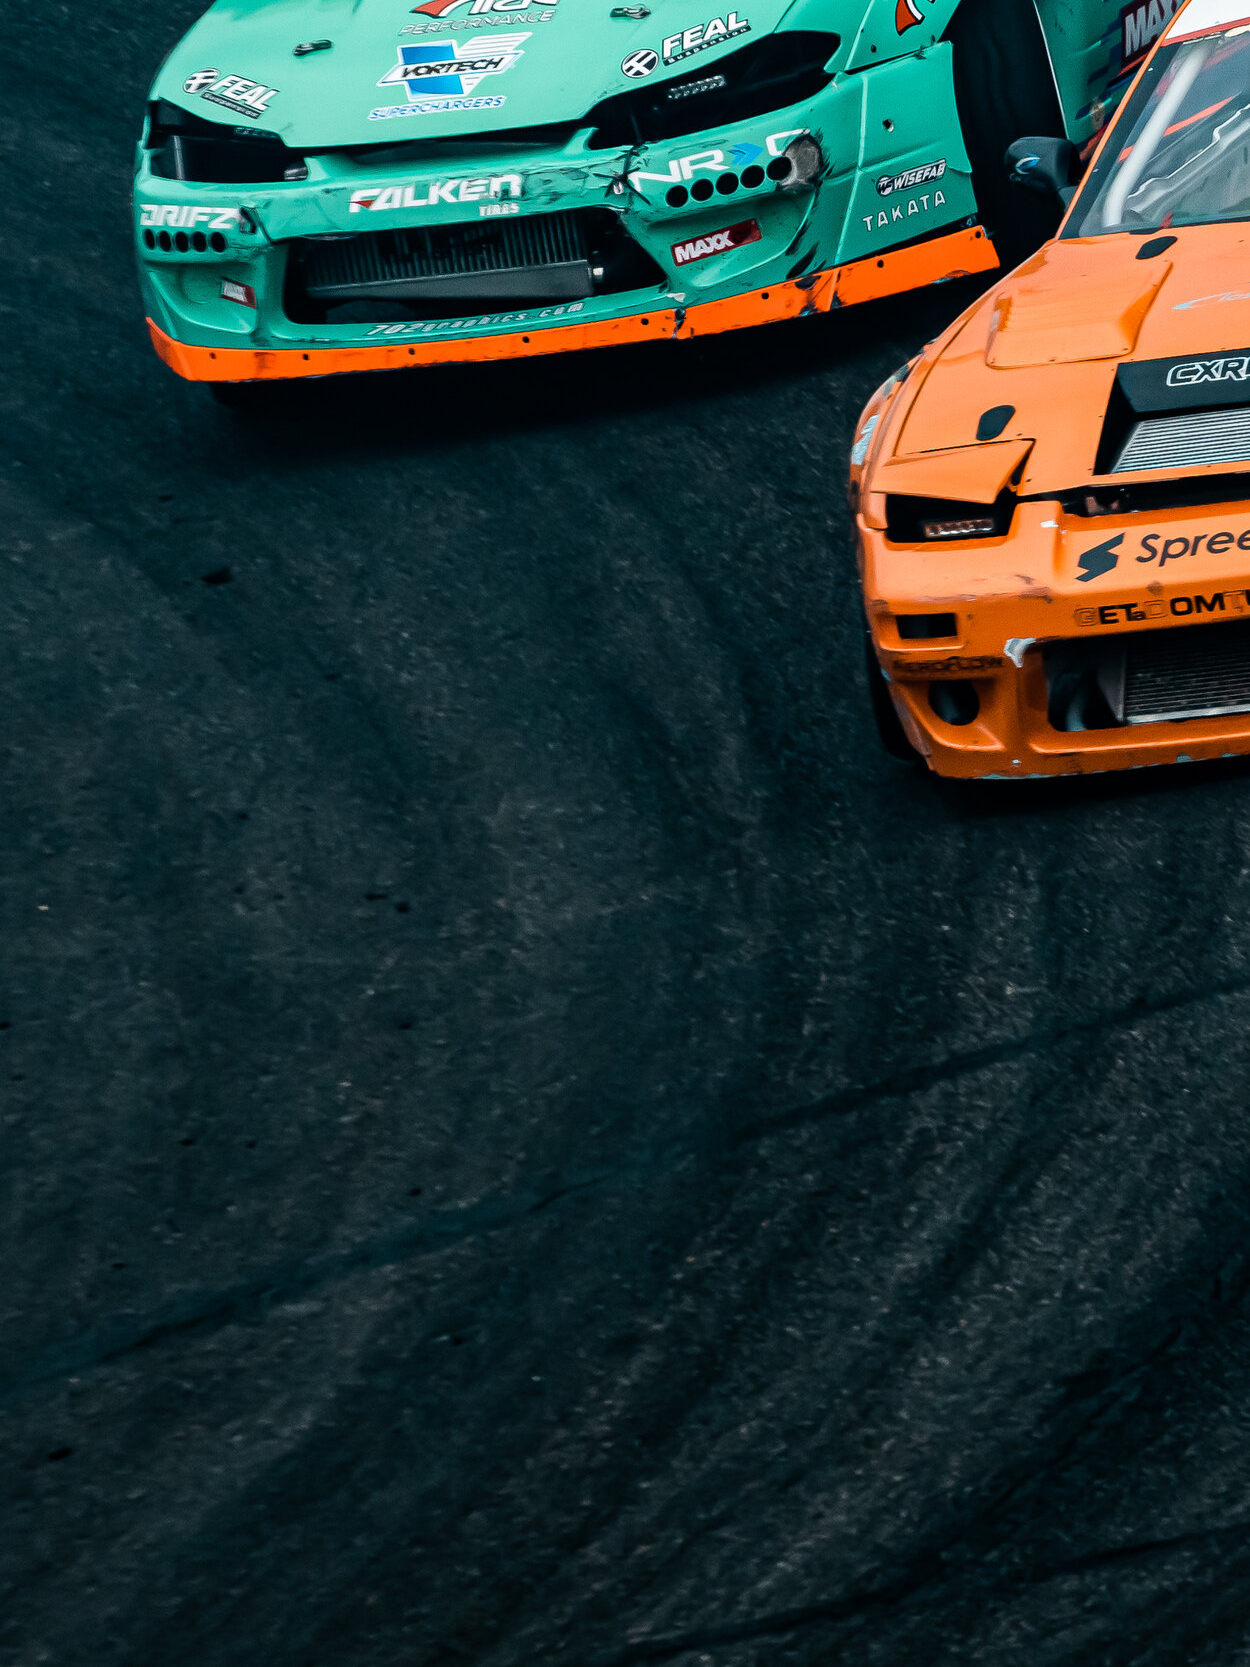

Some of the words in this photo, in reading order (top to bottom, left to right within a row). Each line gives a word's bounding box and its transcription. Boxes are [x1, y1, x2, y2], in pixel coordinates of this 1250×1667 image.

[400, 10, 556, 35] PERFORMANCE
[662, 11, 748, 59] FEAL
[402, 57, 504, 78] VORTECH
[208, 74, 280, 112] FEAL
[370, 96, 505, 120] SUPERCHARGERS
[894, 162, 946, 189] WISEFAB
[348, 174, 522, 213] FALKEN
[140, 204, 240, 229] DRIFZ
[863, 191, 945, 231] TAKATA
[675, 231, 734, 263] MAXX
[367, 302, 584, 335] 702graphics.com
